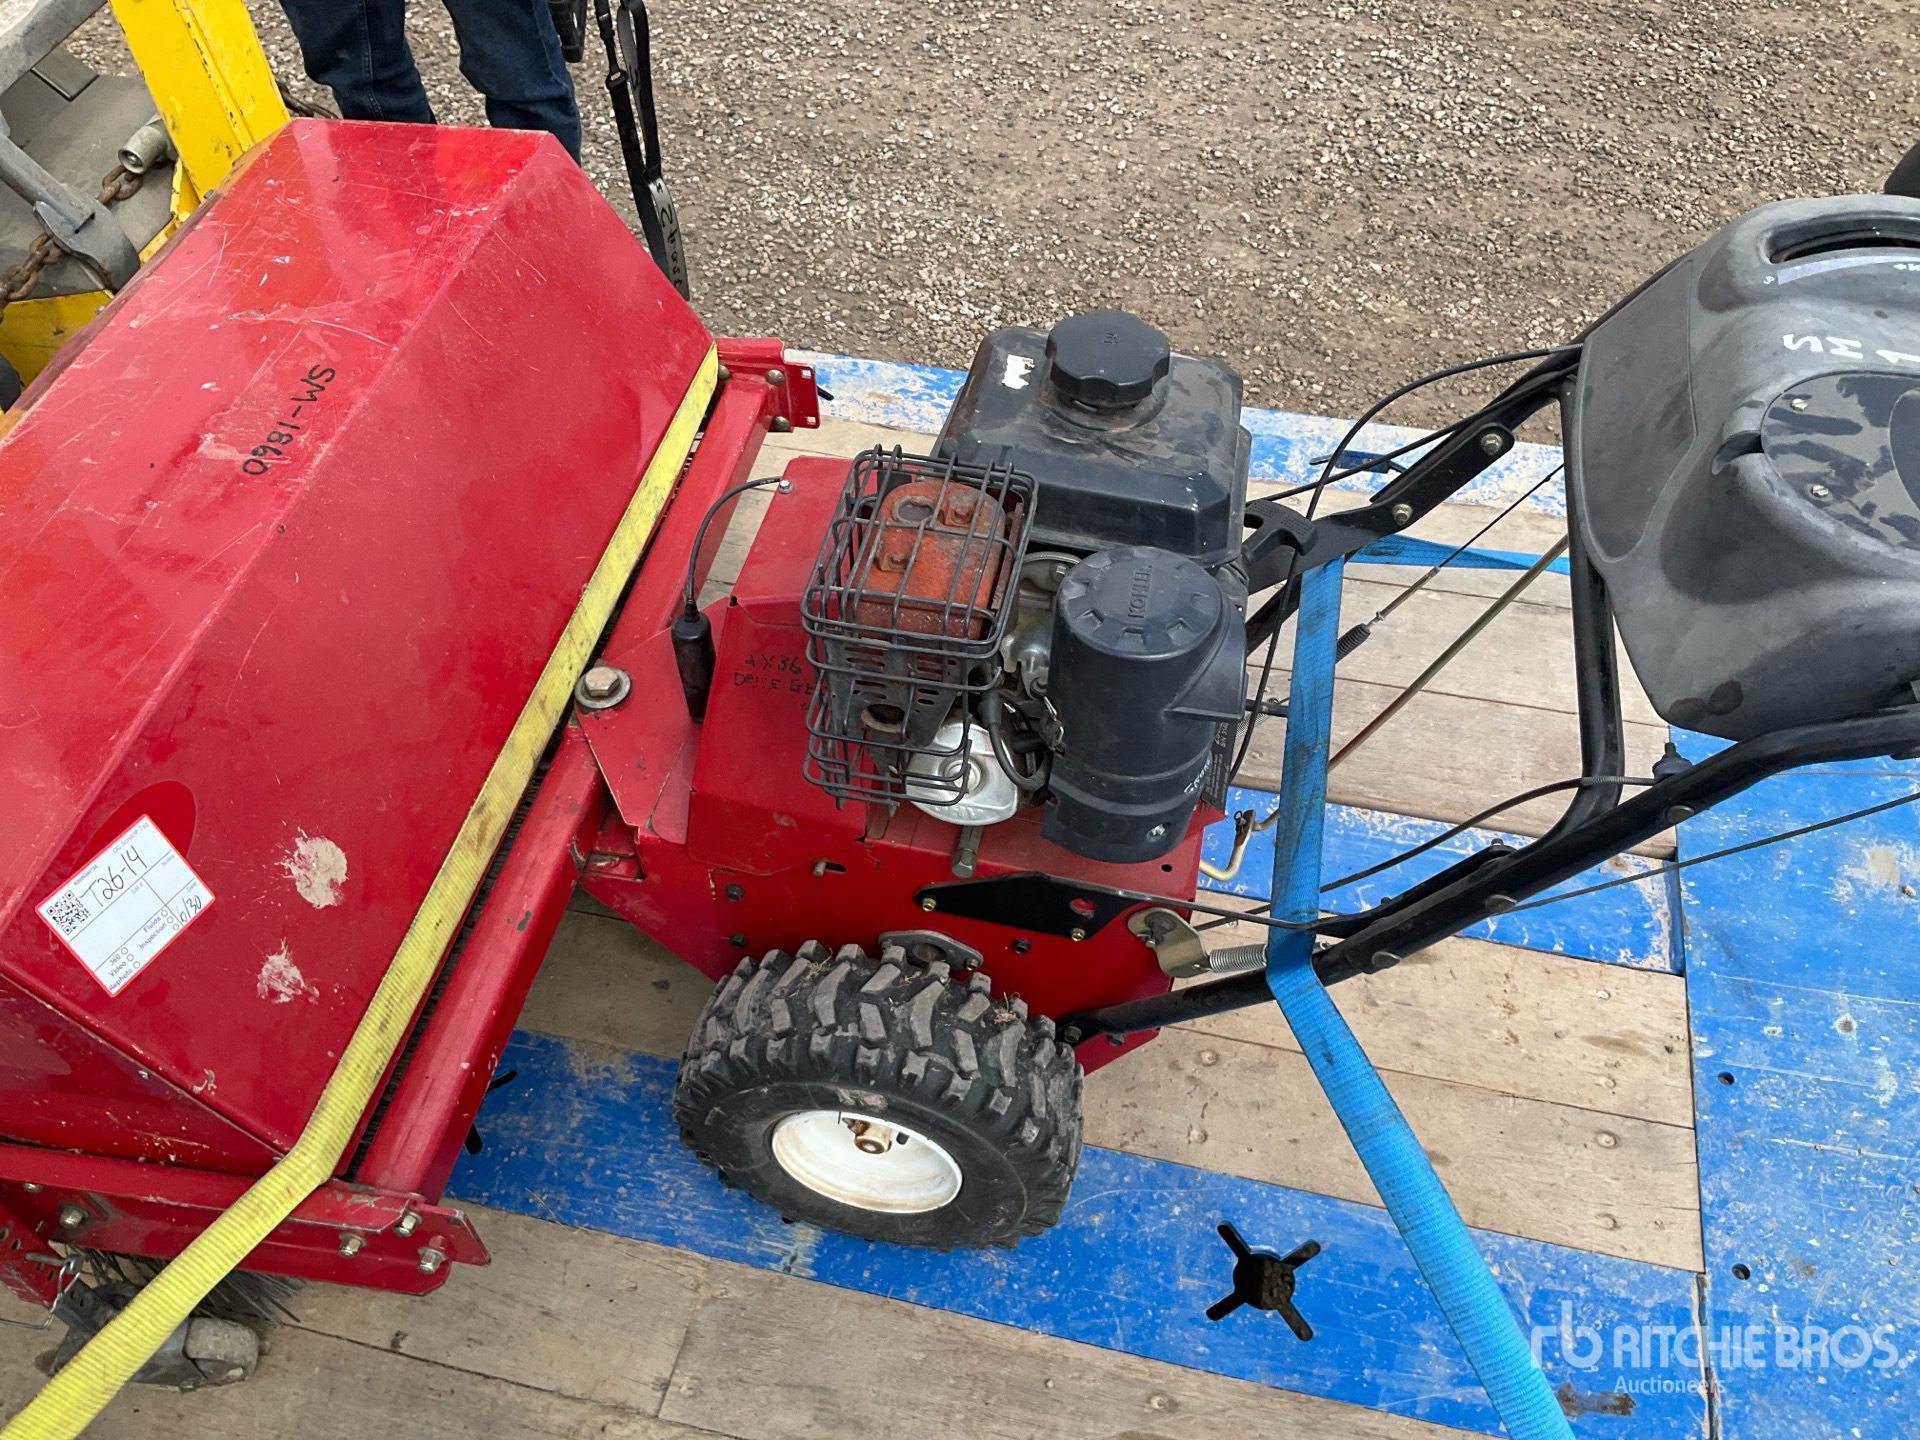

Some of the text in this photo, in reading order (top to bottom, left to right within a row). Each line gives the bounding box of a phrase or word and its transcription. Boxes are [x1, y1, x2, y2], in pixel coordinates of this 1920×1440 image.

[242, 364, 336, 475] SM-1860
[80, 845, 148, 907] T26-14
[175, 895, 202, 923] 6/30
[139, 923, 167, 950] Inspection
[143, 916, 161, 933] Fluids
[108, 961, 127, 978] Video
[109, 954, 121, 966] 360
[108, 968, 133, 992] Rephoto
